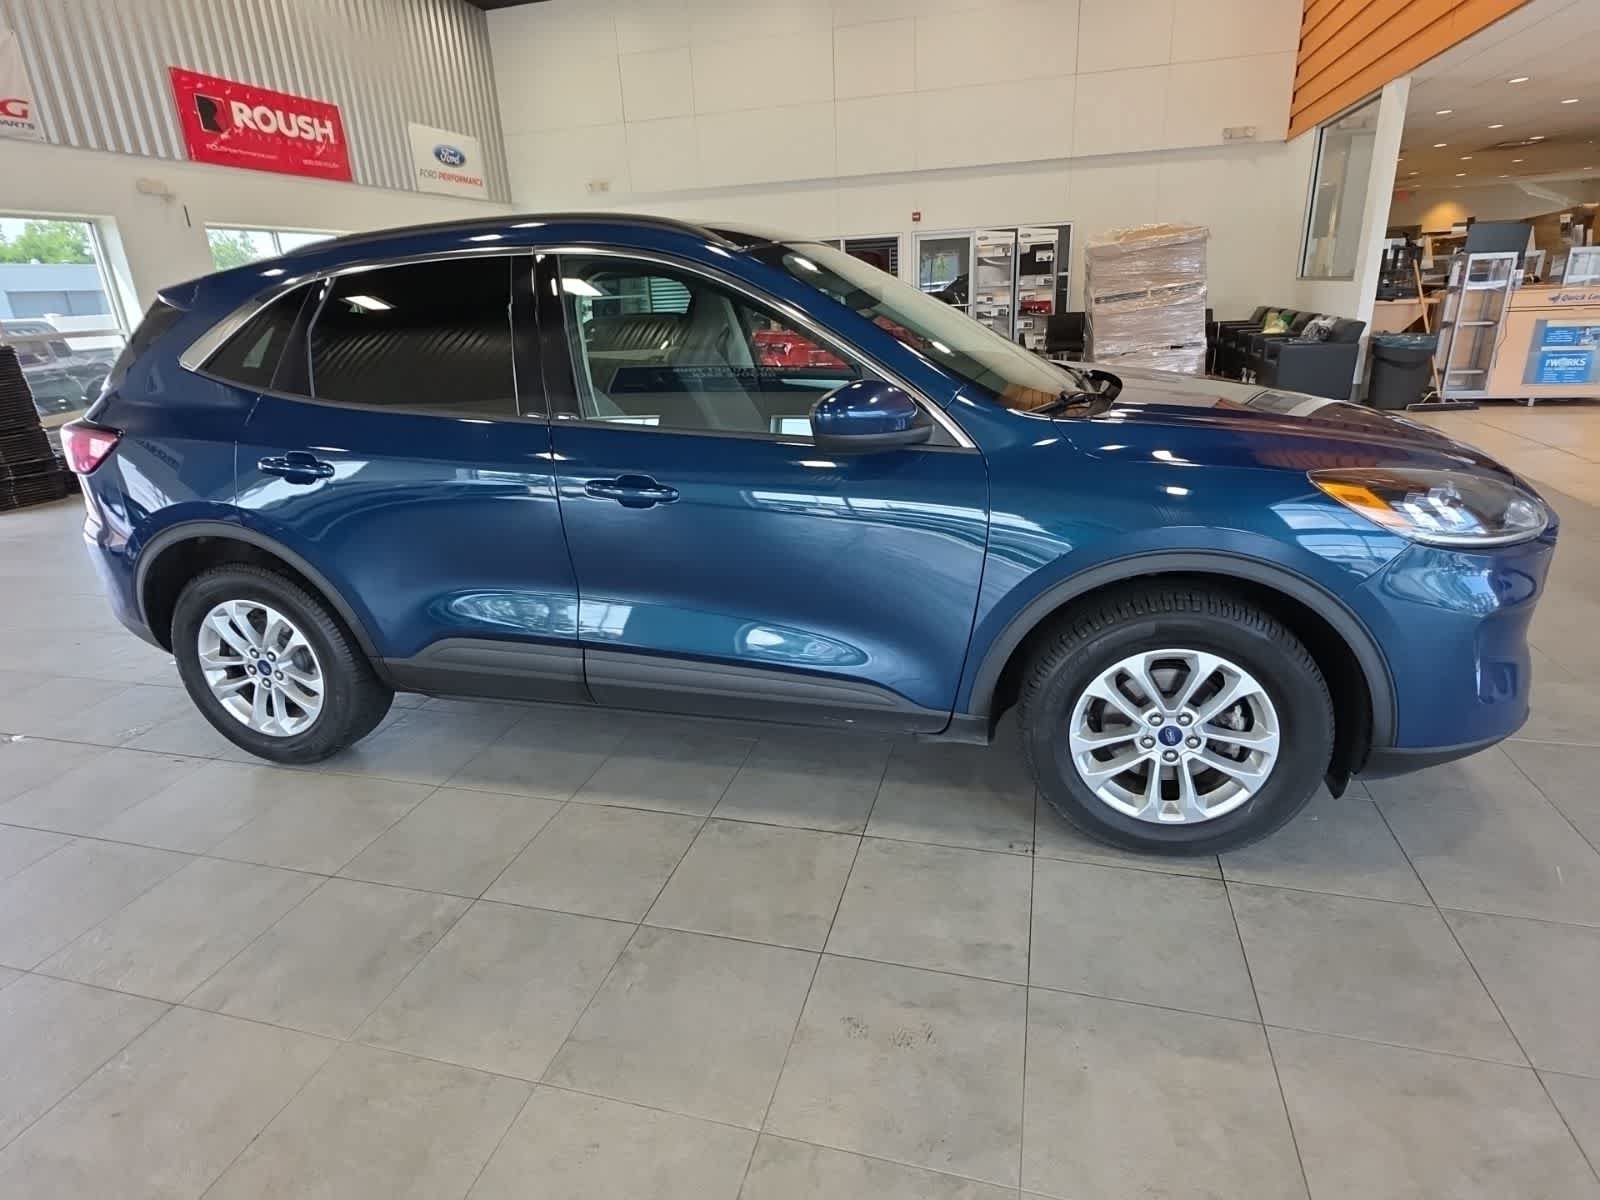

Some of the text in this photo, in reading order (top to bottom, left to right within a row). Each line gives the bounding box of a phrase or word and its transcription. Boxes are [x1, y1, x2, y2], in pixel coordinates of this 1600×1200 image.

[0, 99, 29, 118] G
[230, 100, 336, 145] ROUSH
[438, 147, 462, 166] Ford
